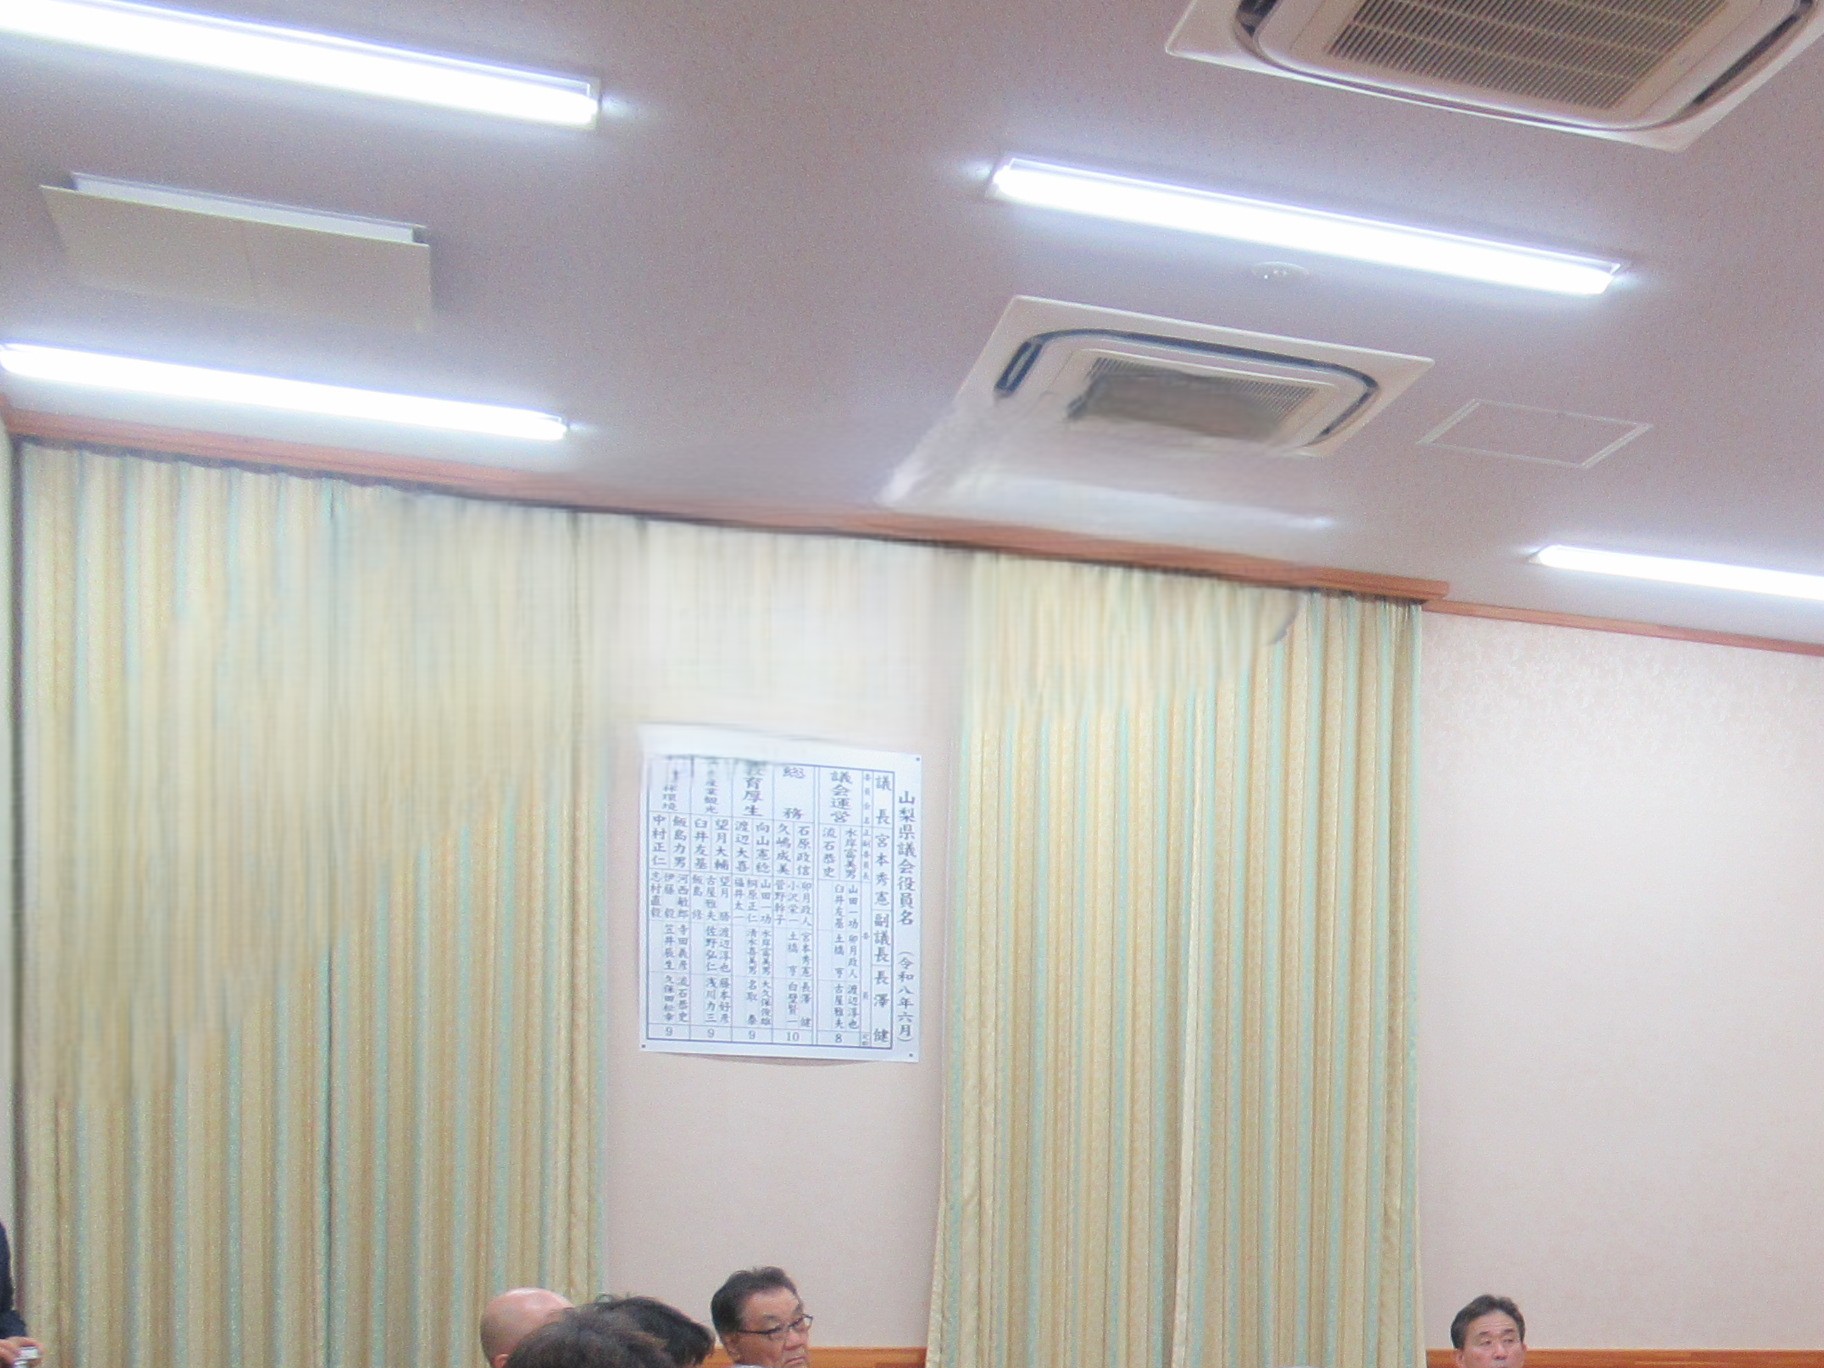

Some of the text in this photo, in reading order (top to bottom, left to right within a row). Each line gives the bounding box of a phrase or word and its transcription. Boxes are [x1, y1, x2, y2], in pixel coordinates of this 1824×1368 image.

[830, 771, 852, 823] 議会運営
[652, 815, 667, 866] 中村正仁
[897, 791, 917, 925] 山梨県議会役員名
[876, 833, 891, 907] 宮本秀憲
[802, 932, 811, 977] 宮本秀憲
[874, 913, 891, 962] 副議長
[665, 1026, 673, 1037] 9
[707, 1028, 715, 1038] 9
[748, 1030, 756, 1040] 9
[786, 1031, 800, 1041] 10
[835, 1033, 843, 1043] 8
